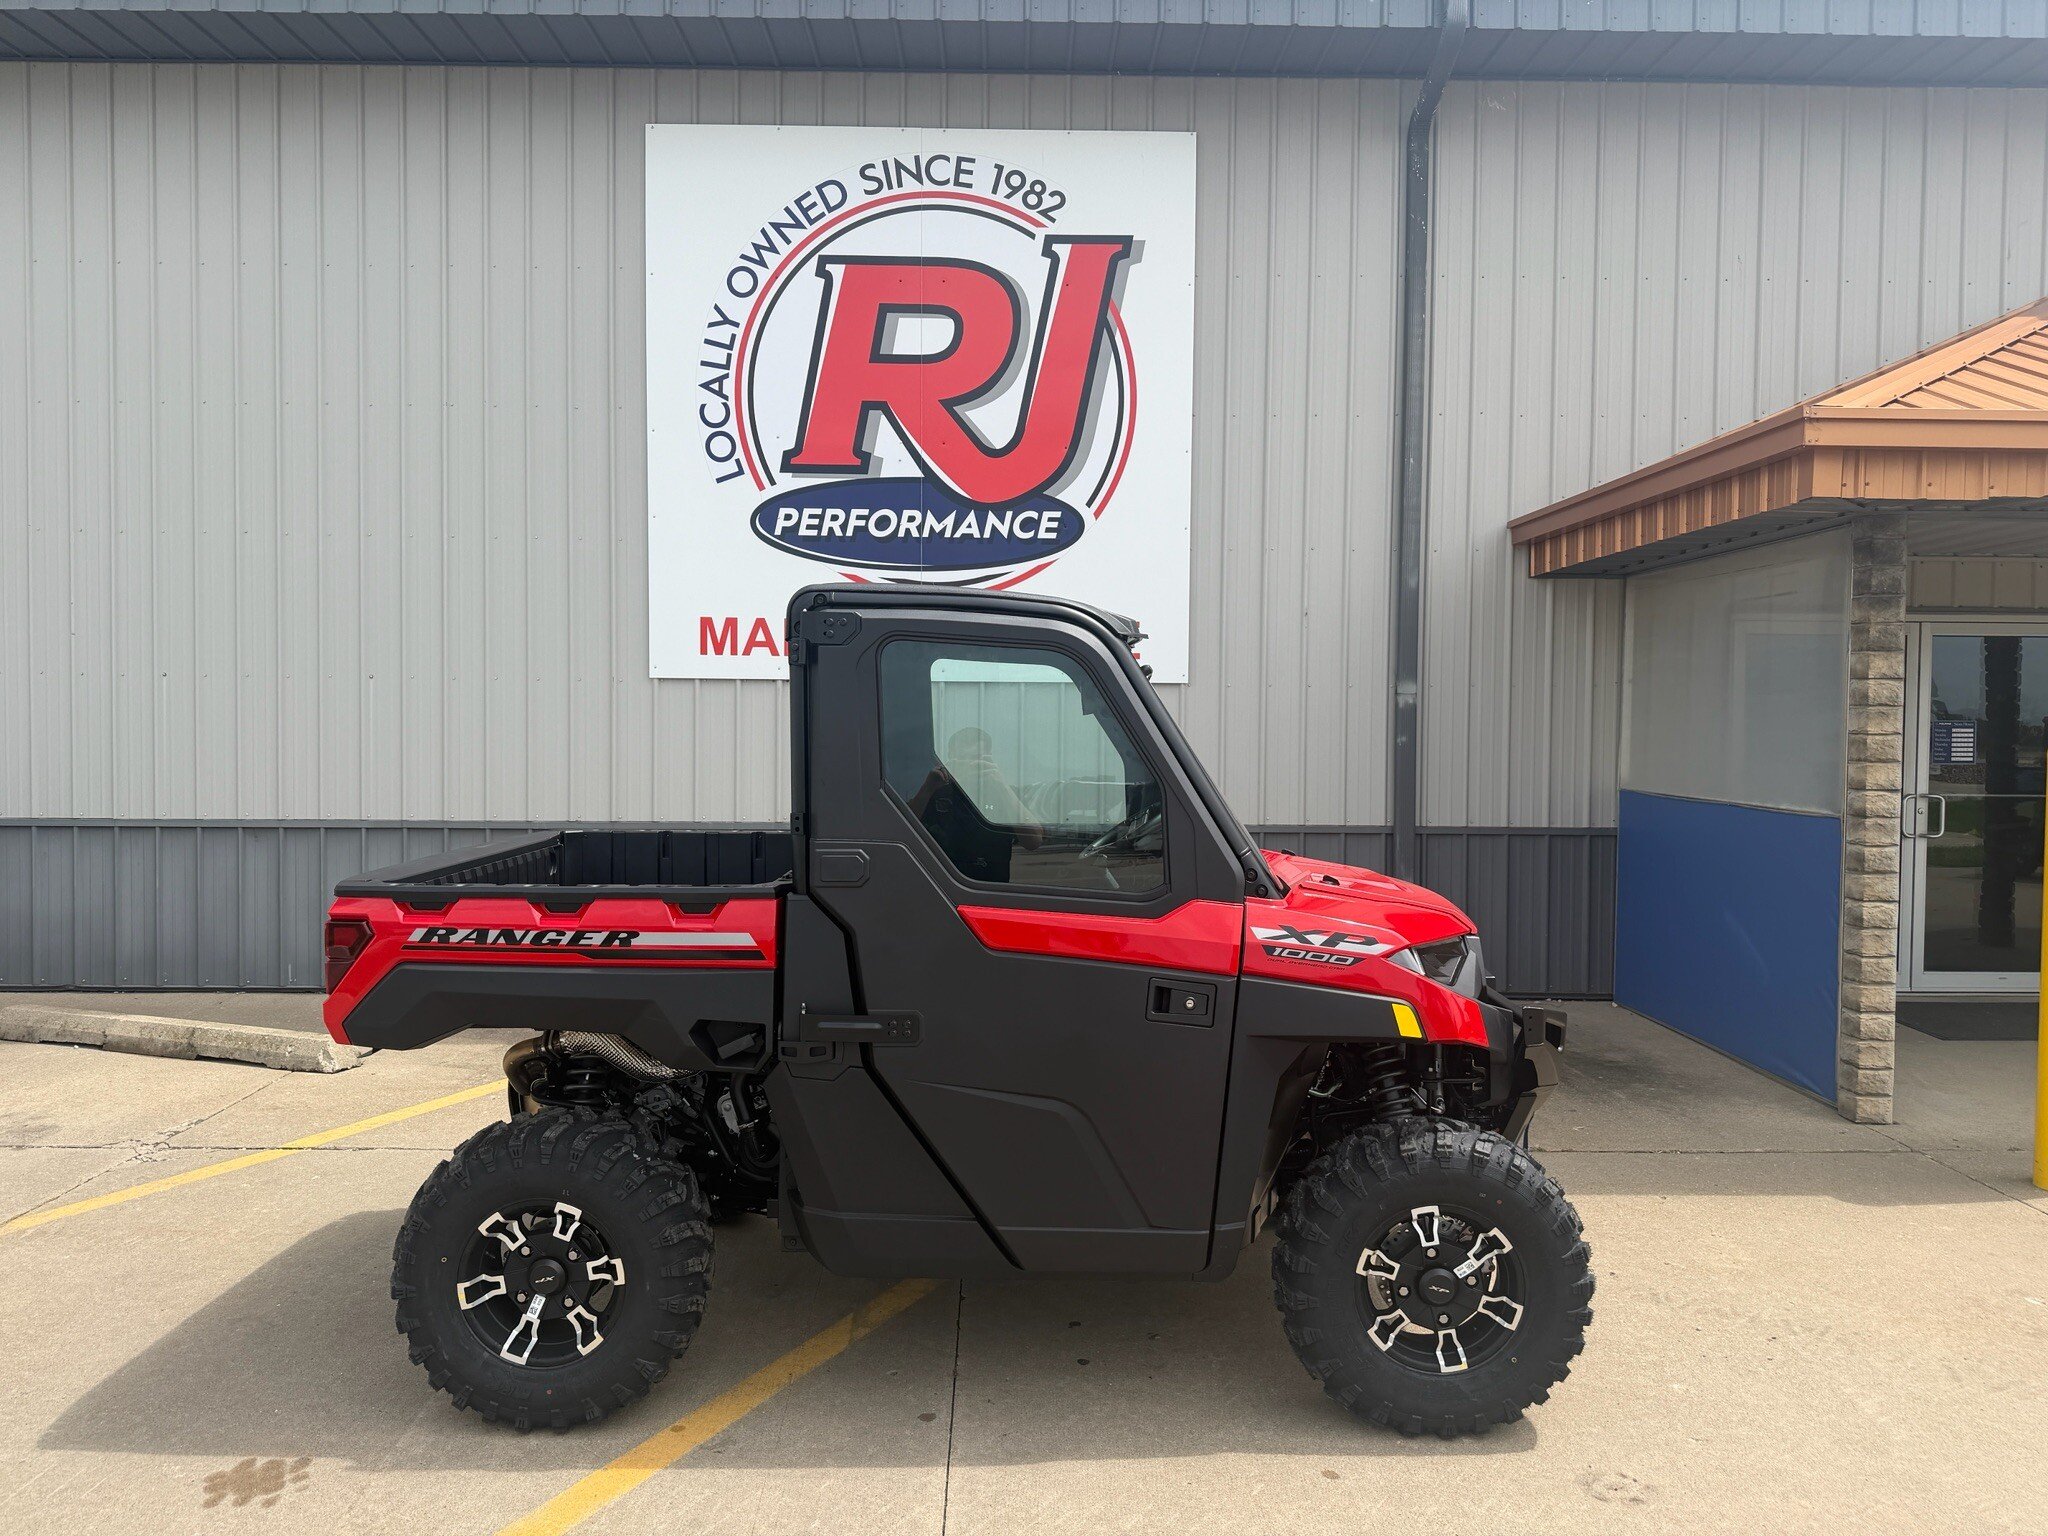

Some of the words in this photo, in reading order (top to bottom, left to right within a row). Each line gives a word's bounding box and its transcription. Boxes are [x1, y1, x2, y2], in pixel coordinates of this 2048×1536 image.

[698, 303, 745, 484] LOCALLY
[726, 179, 848, 298] OWNED
[859, 154, 976, 196] SINCE
[991, 162, 1067, 224] 1982
[780, 235, 1134, 509] RJ
[774, 507, 1062, 540] PERFORMANCE
[416, 926, 641, 948] RANGER
[1261, 925, 1380, 948] XP
[1272, 947, 1355, 966] 1000
